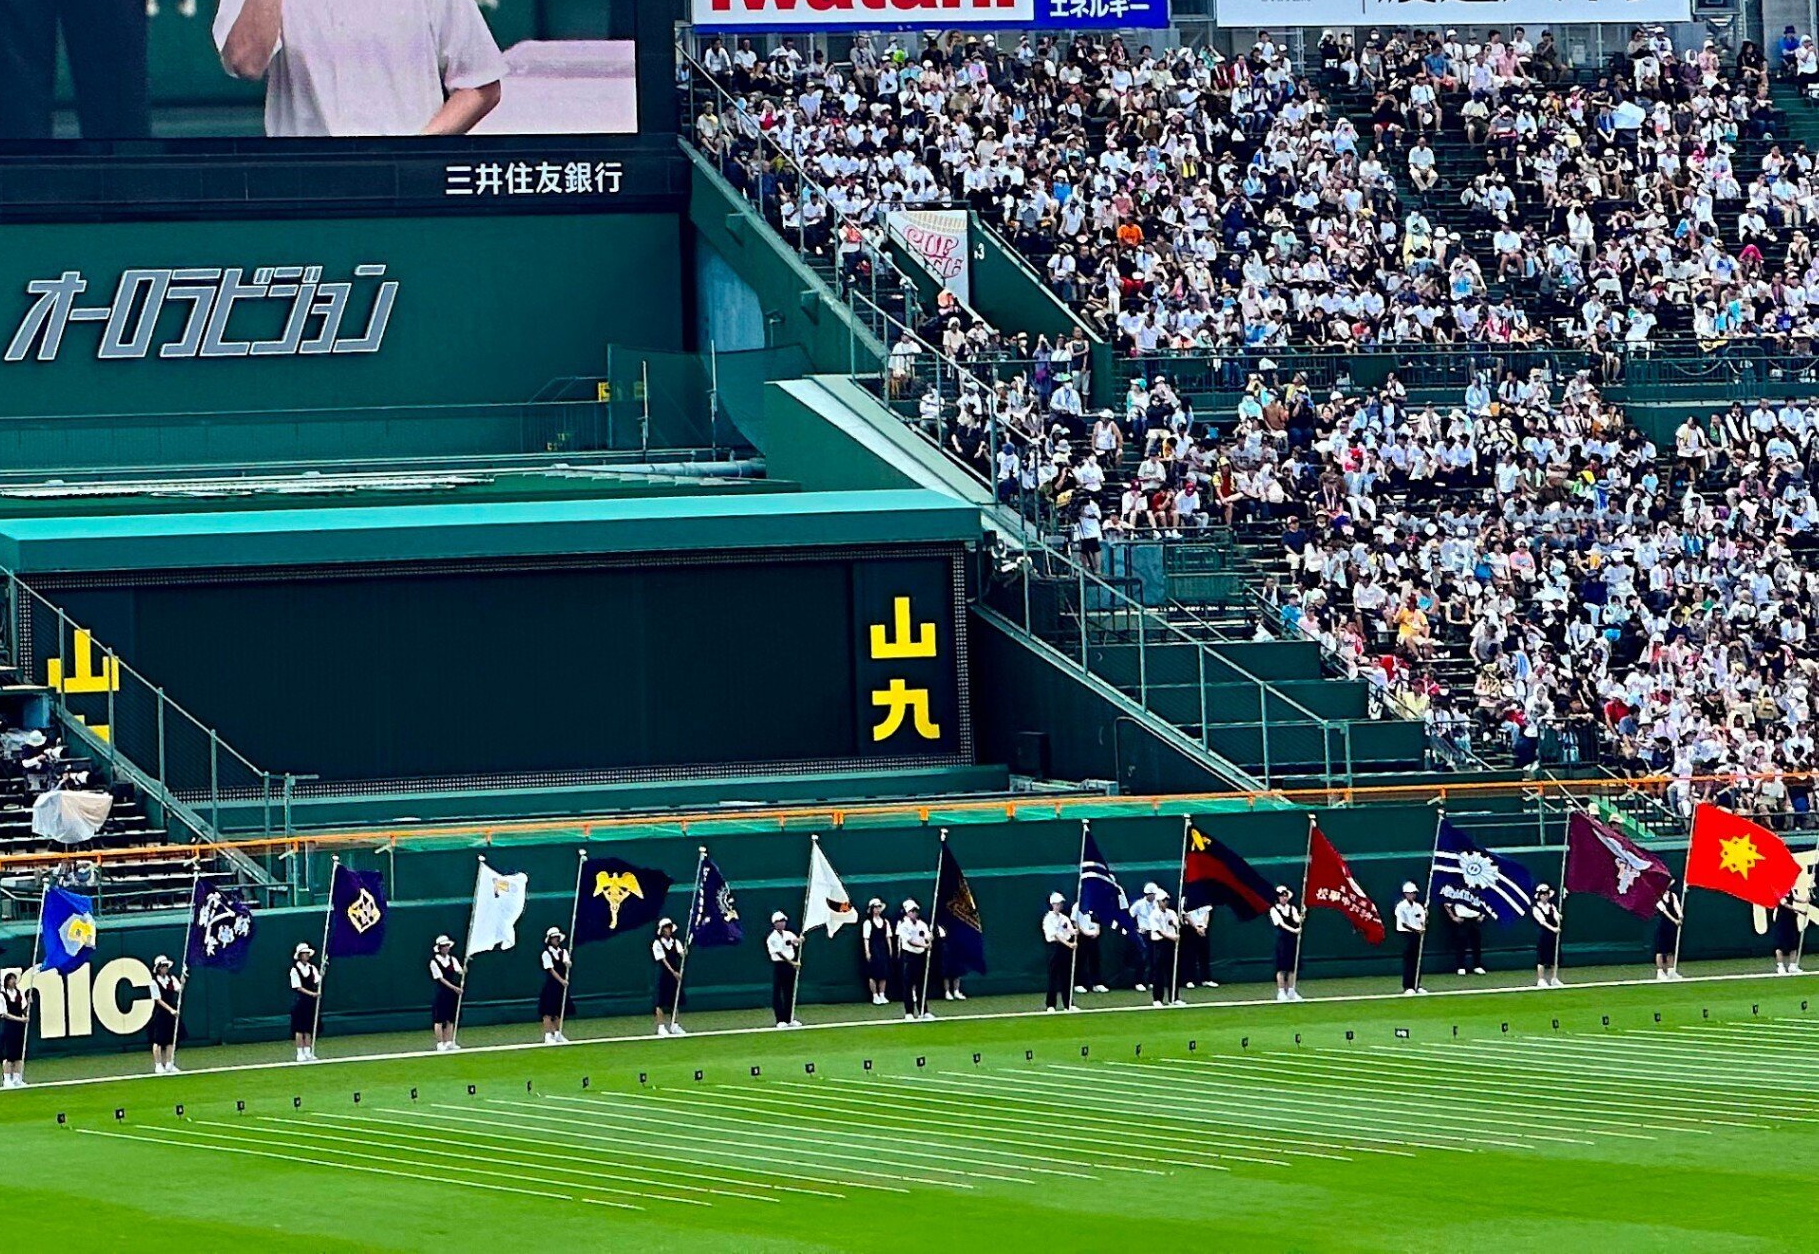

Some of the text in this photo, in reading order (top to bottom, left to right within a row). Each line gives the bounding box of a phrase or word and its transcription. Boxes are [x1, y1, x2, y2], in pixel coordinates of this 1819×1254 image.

[446, 161, 623, 196] 三井住友銀行
[4, 265, 399, 361] オーロラビジョン
[871, 597, 940, 741] 山九
